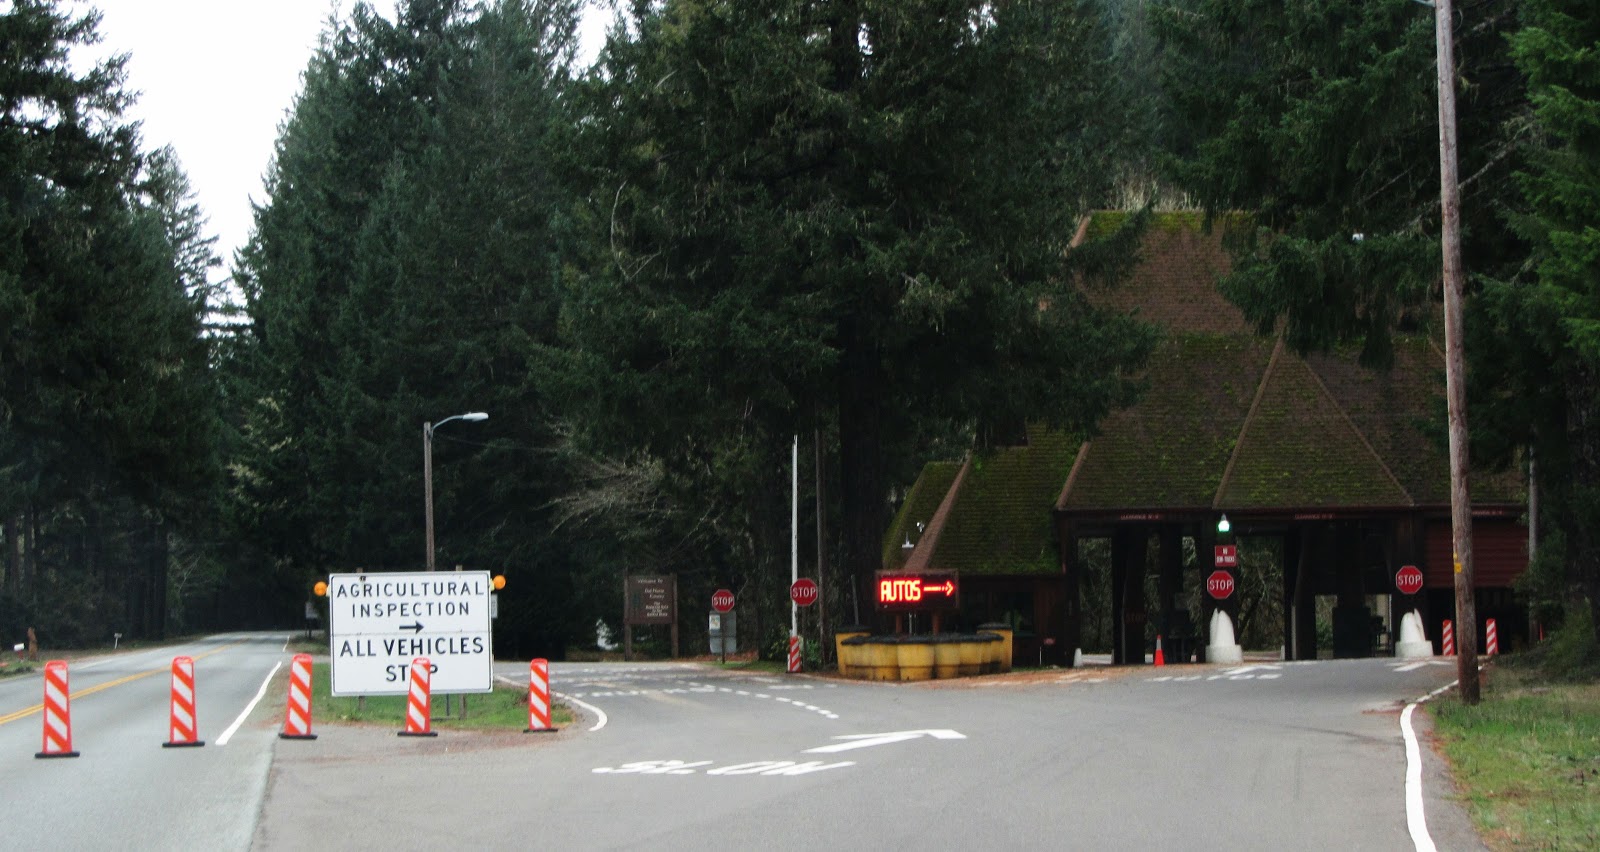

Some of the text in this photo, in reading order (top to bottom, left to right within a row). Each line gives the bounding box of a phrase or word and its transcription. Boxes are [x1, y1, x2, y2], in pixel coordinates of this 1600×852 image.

[1209, 579, 1233, 591] STOP
[1397, 574, 1421, 586] STOP
[336, 581, 485, 598] AGRICULTURAL
[793, 587, 816, 598] STOP
[880, 580, 921, 602] AUTOS
[713, 597, 734, 606] STOP
[352, 602, 469, 618] INSPECTION
[340, 637, 484, 657] ALL VEHICLES
[386, 664, 438, 682] STP
[591, 759, 857, 776] SLOW
